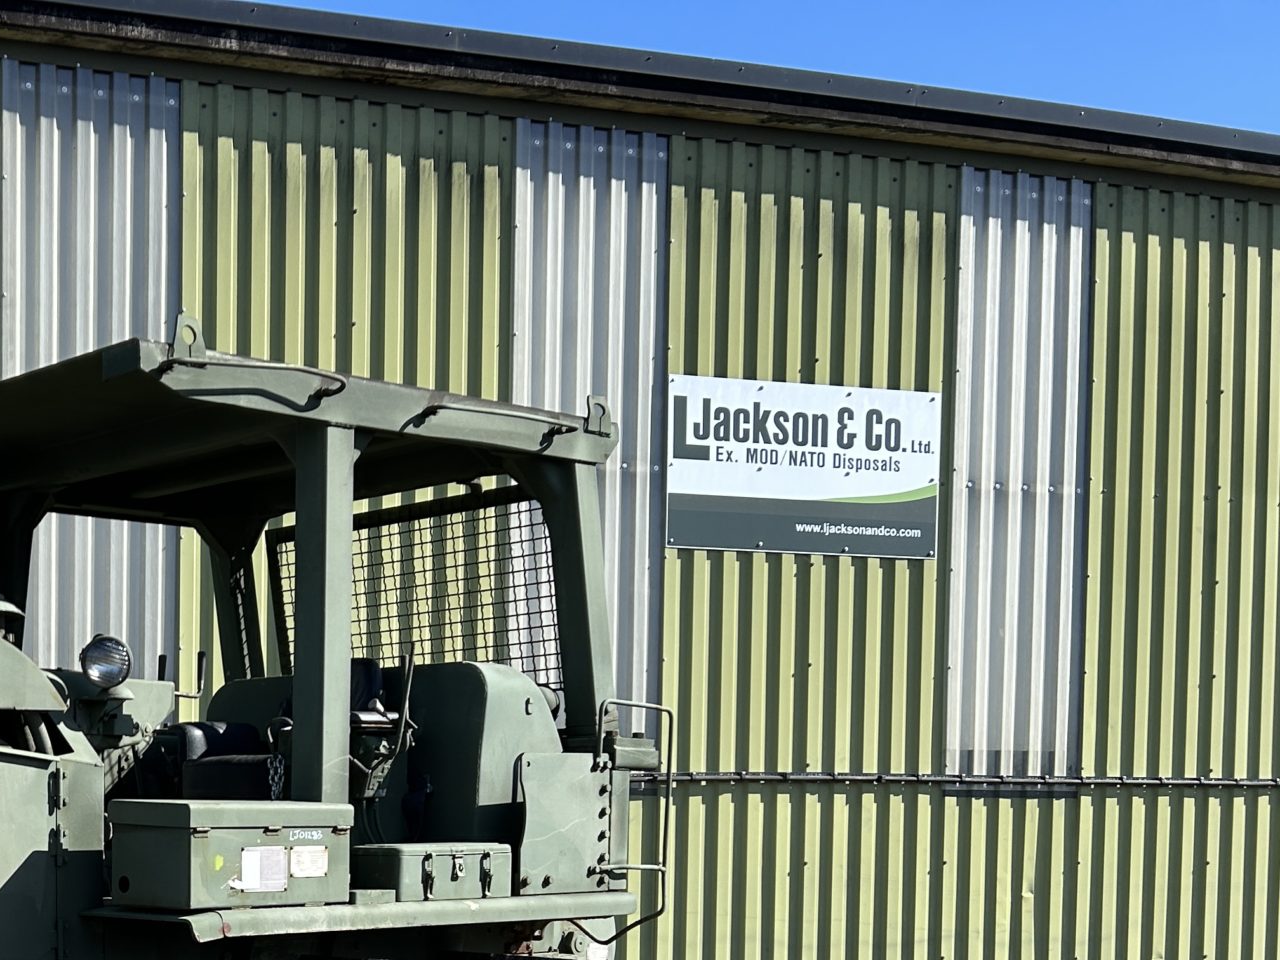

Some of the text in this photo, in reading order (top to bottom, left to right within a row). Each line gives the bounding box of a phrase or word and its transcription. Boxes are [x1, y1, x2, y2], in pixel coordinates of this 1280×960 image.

[837, 407, 857, 449] &
[865, 409, 907, 452] Co.
[911, 440, 934, 454] Ltd.
[716, 446, 900, 472] Ex. MOD/NATO Disposals
[796, 523, 921, 538] www.ljacksonandco.com
